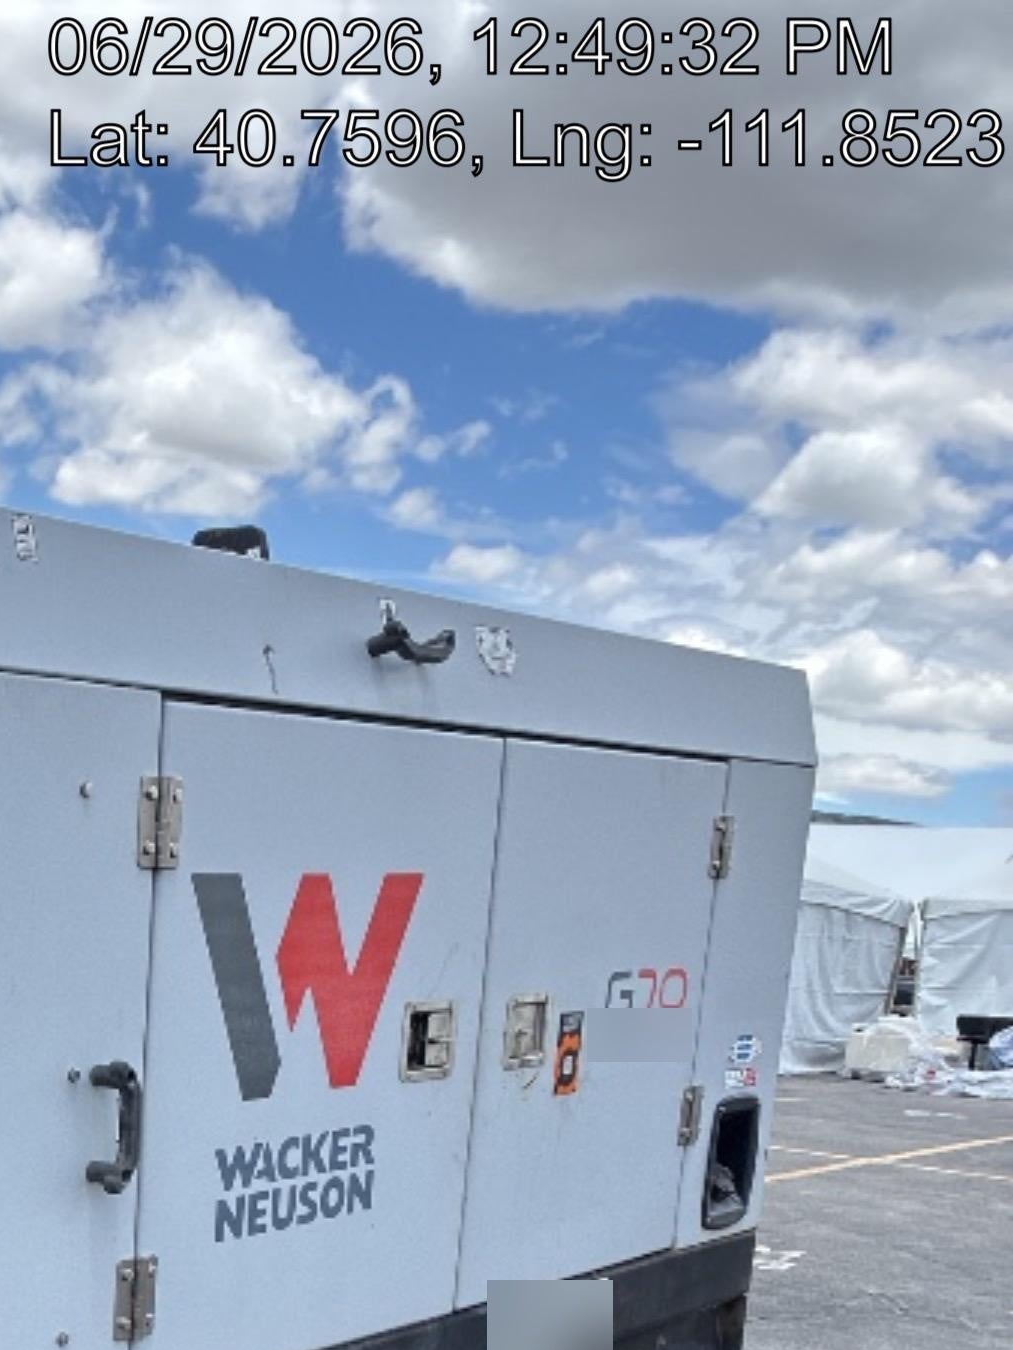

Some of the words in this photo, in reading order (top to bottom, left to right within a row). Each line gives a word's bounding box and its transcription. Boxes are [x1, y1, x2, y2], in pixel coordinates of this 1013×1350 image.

[604, 967, 688, 1009] G70
[214, 1124, 375, 1192] WACKER
[214, 1169, 375, 1242] NEUSON
